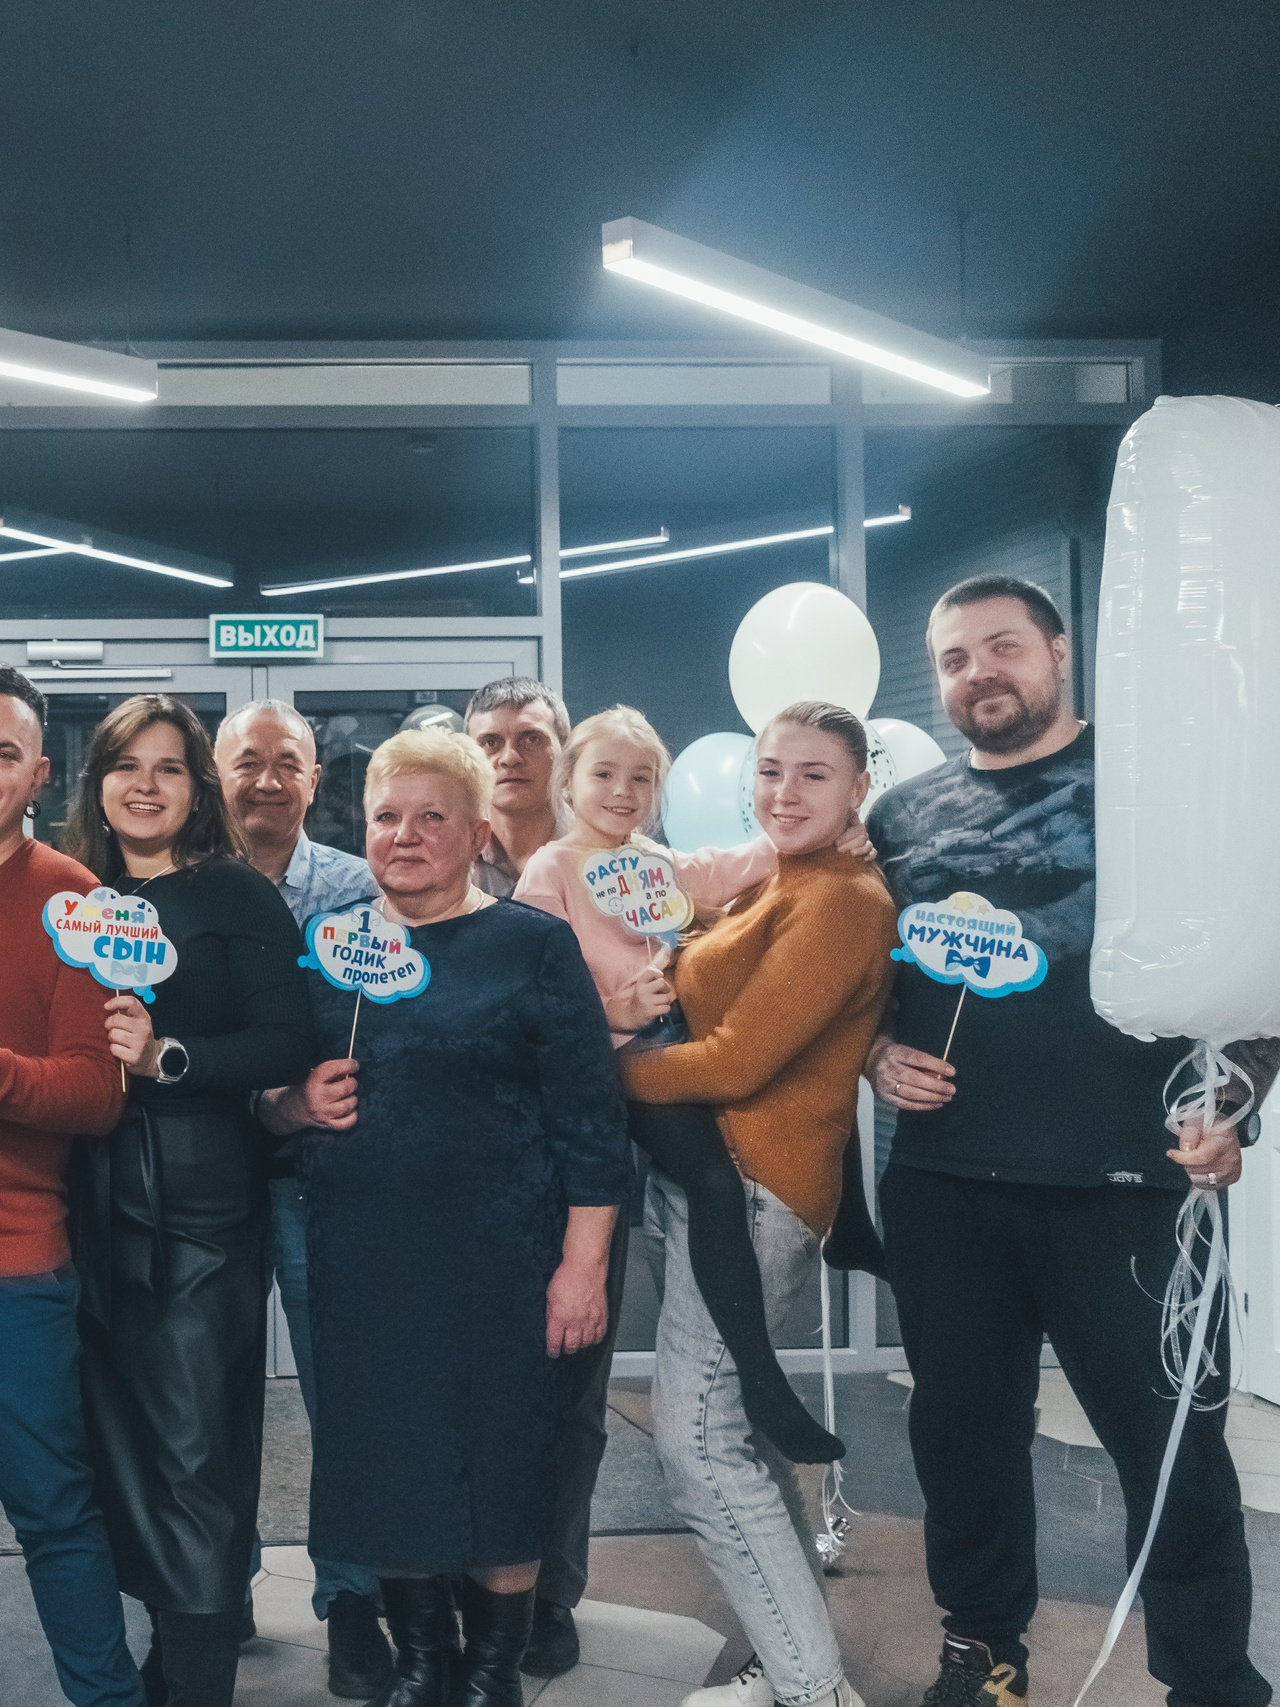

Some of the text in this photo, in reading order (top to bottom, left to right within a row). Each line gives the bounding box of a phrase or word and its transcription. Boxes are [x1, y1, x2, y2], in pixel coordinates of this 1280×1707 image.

[220, 624, 316, 648] ВЫХОД
[586, 856, 639, 886] РАСТУ
[646, 889, 667, 900] а по
[64, 899, 78, 916] У
[56, 918, 159, 940] САМЫЙ ЛУЧШИЙ
[358, 910, 371, 933] 1
[915, 909, 1016, 937] НАСТОЯЩИЙ
[93, 935, 166, 965] СЫН
[323, 926, 401, 955] ПЕРВЫЙ
[907, 923, 1029, 962] МУЖЧИНА
[332, 944, 387, 969] ГОДИК
[342, 962, 417, 985] пролетел
